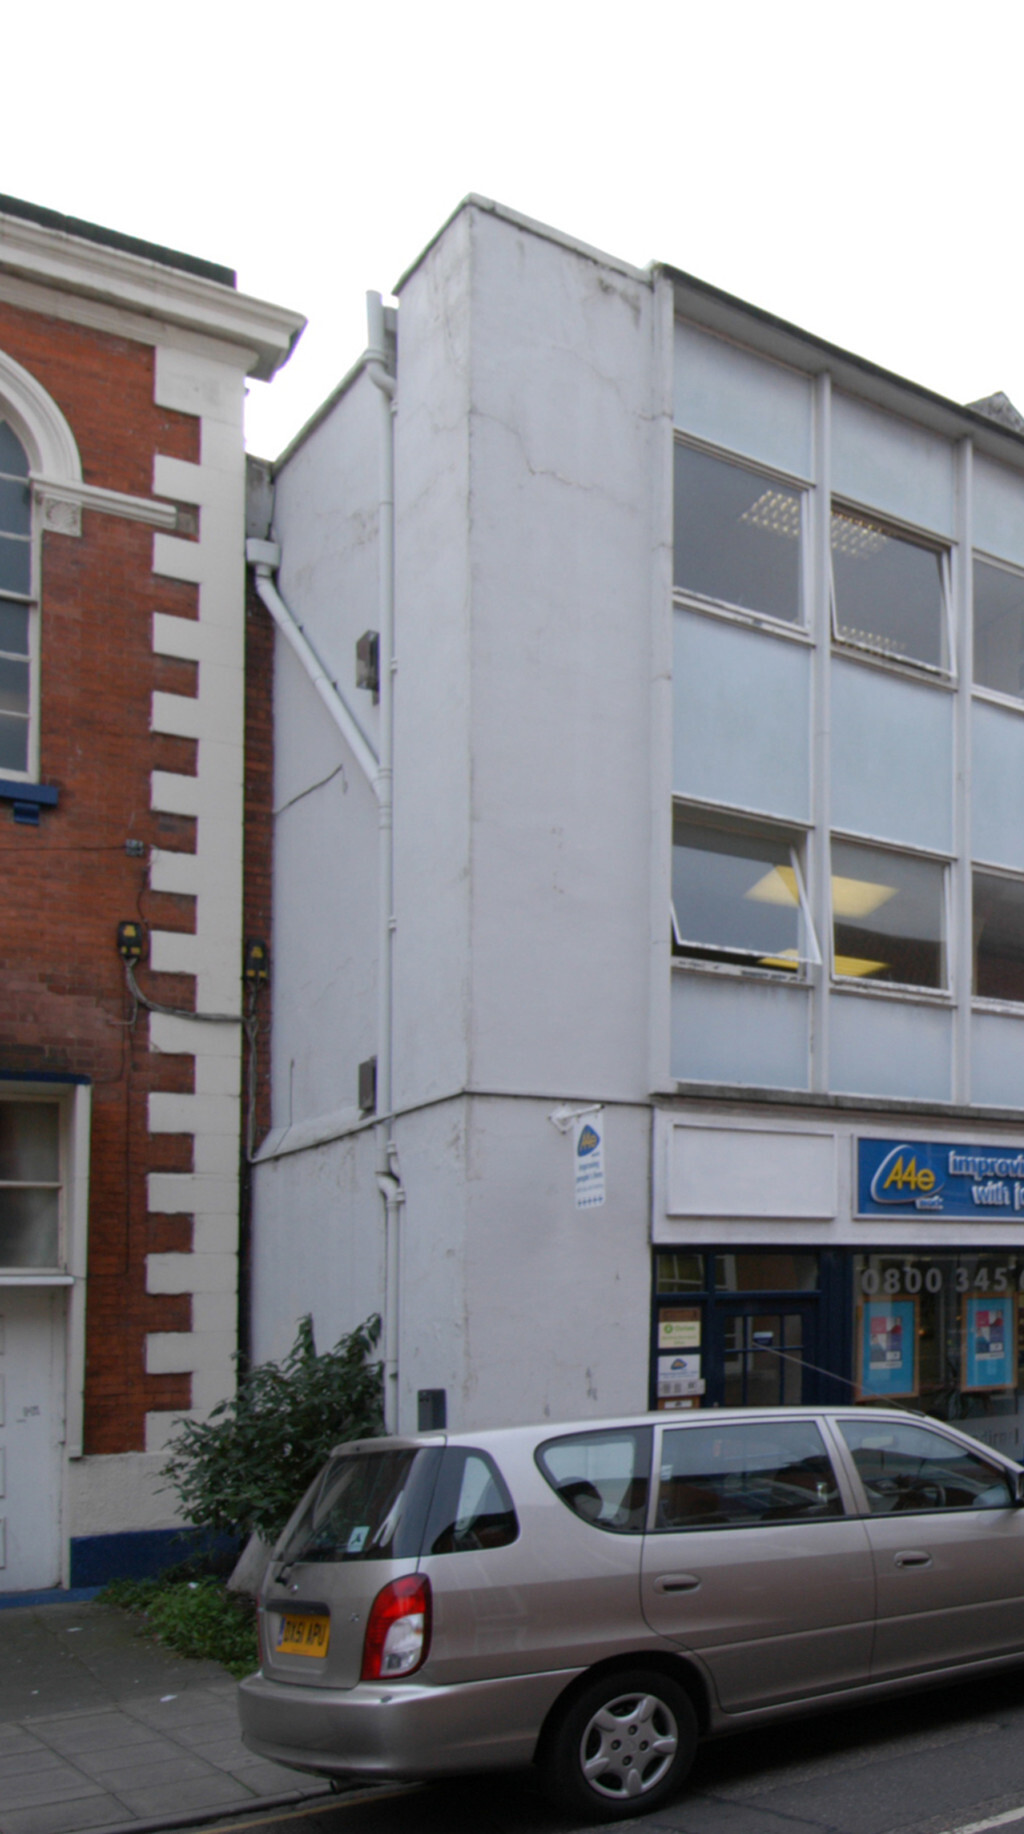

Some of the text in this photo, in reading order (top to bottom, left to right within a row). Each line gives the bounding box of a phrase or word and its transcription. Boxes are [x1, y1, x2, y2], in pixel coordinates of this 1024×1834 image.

[882, 1156, 935, 1191] A4e
[971, 1182, 1010, 1206] with
[861, 1267, 943, 1294] 0800
[954, 1266, 1010, 1293] 345
